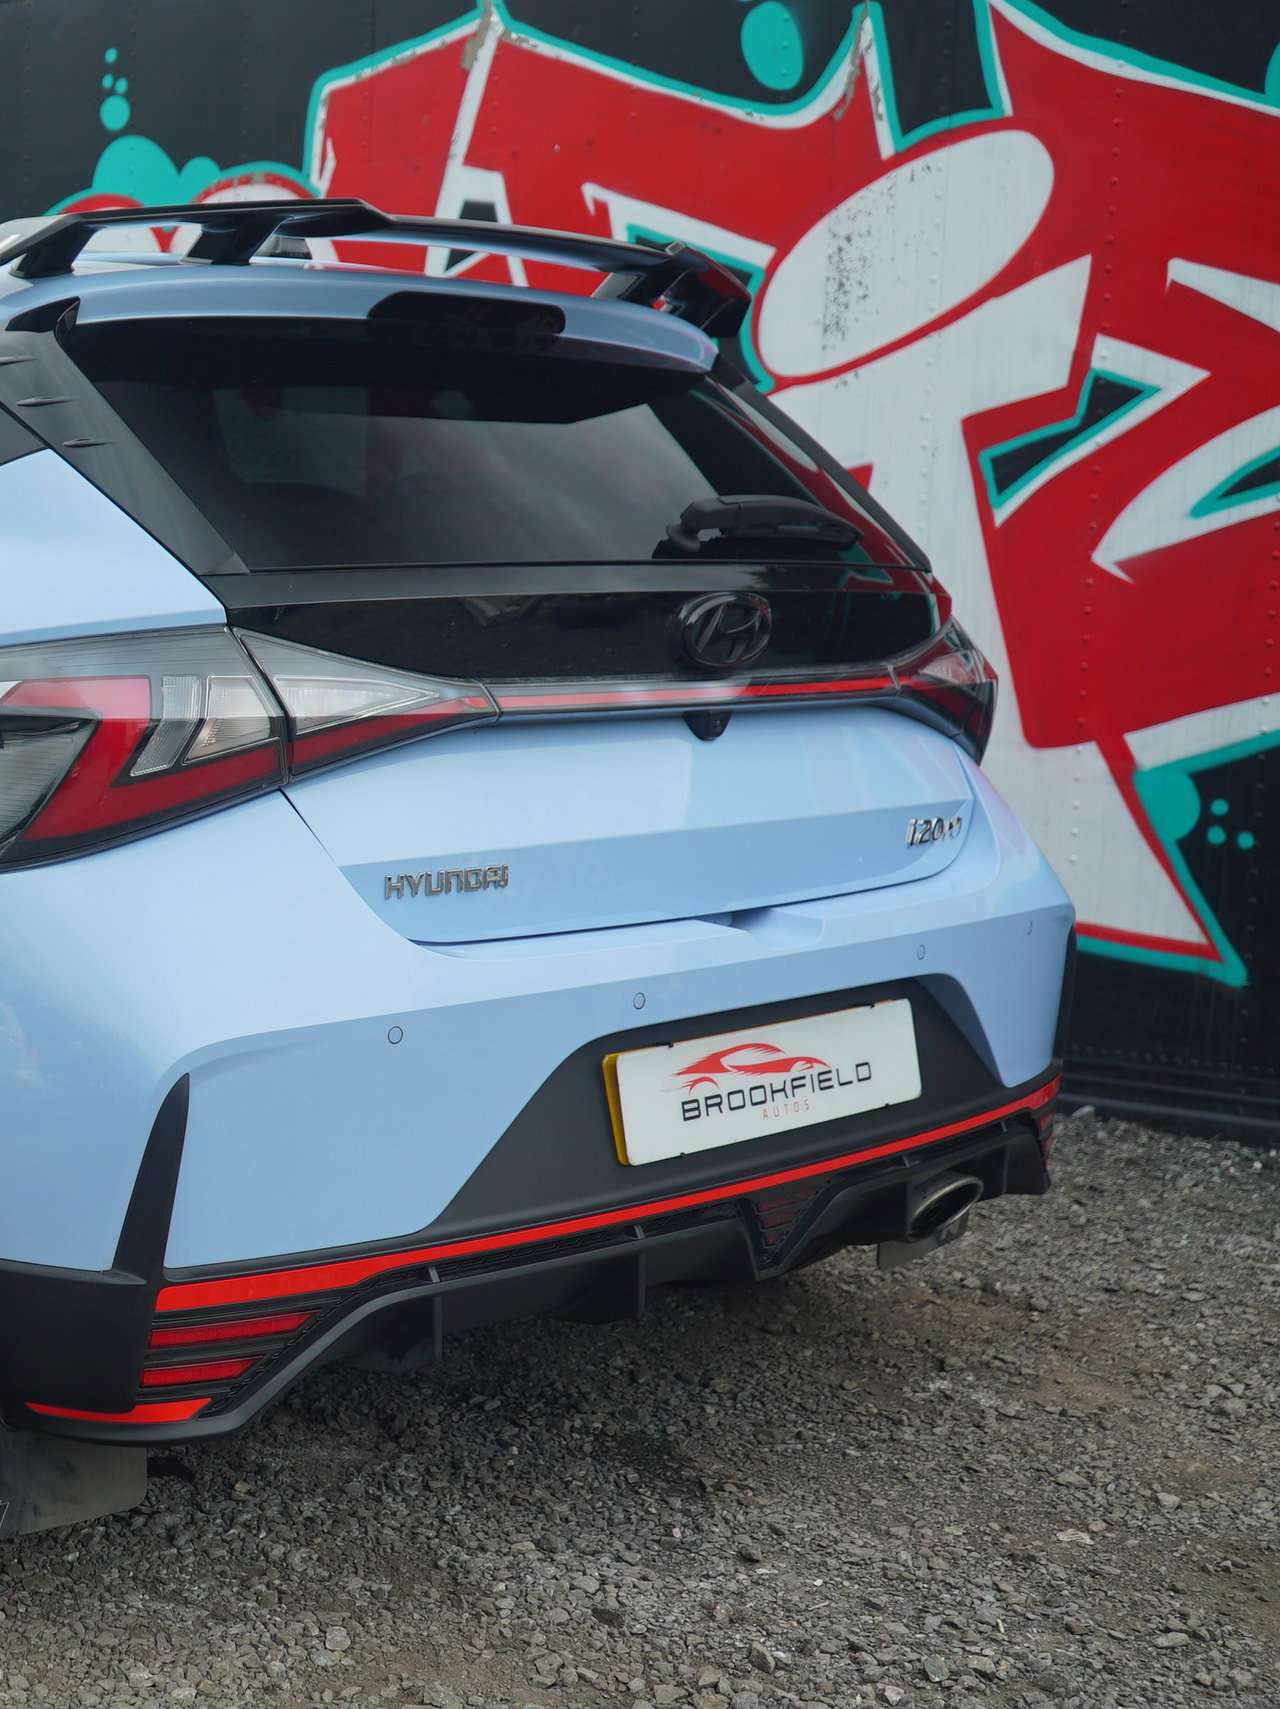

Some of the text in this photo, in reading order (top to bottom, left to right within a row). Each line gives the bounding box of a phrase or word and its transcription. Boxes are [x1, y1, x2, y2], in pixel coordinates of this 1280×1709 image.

[383, 864, 510, 900] HYUNDAI
[681, 1061, 872, 1122] BROOKFIELD
[762, 1099, 811, 1121] AUTOS
